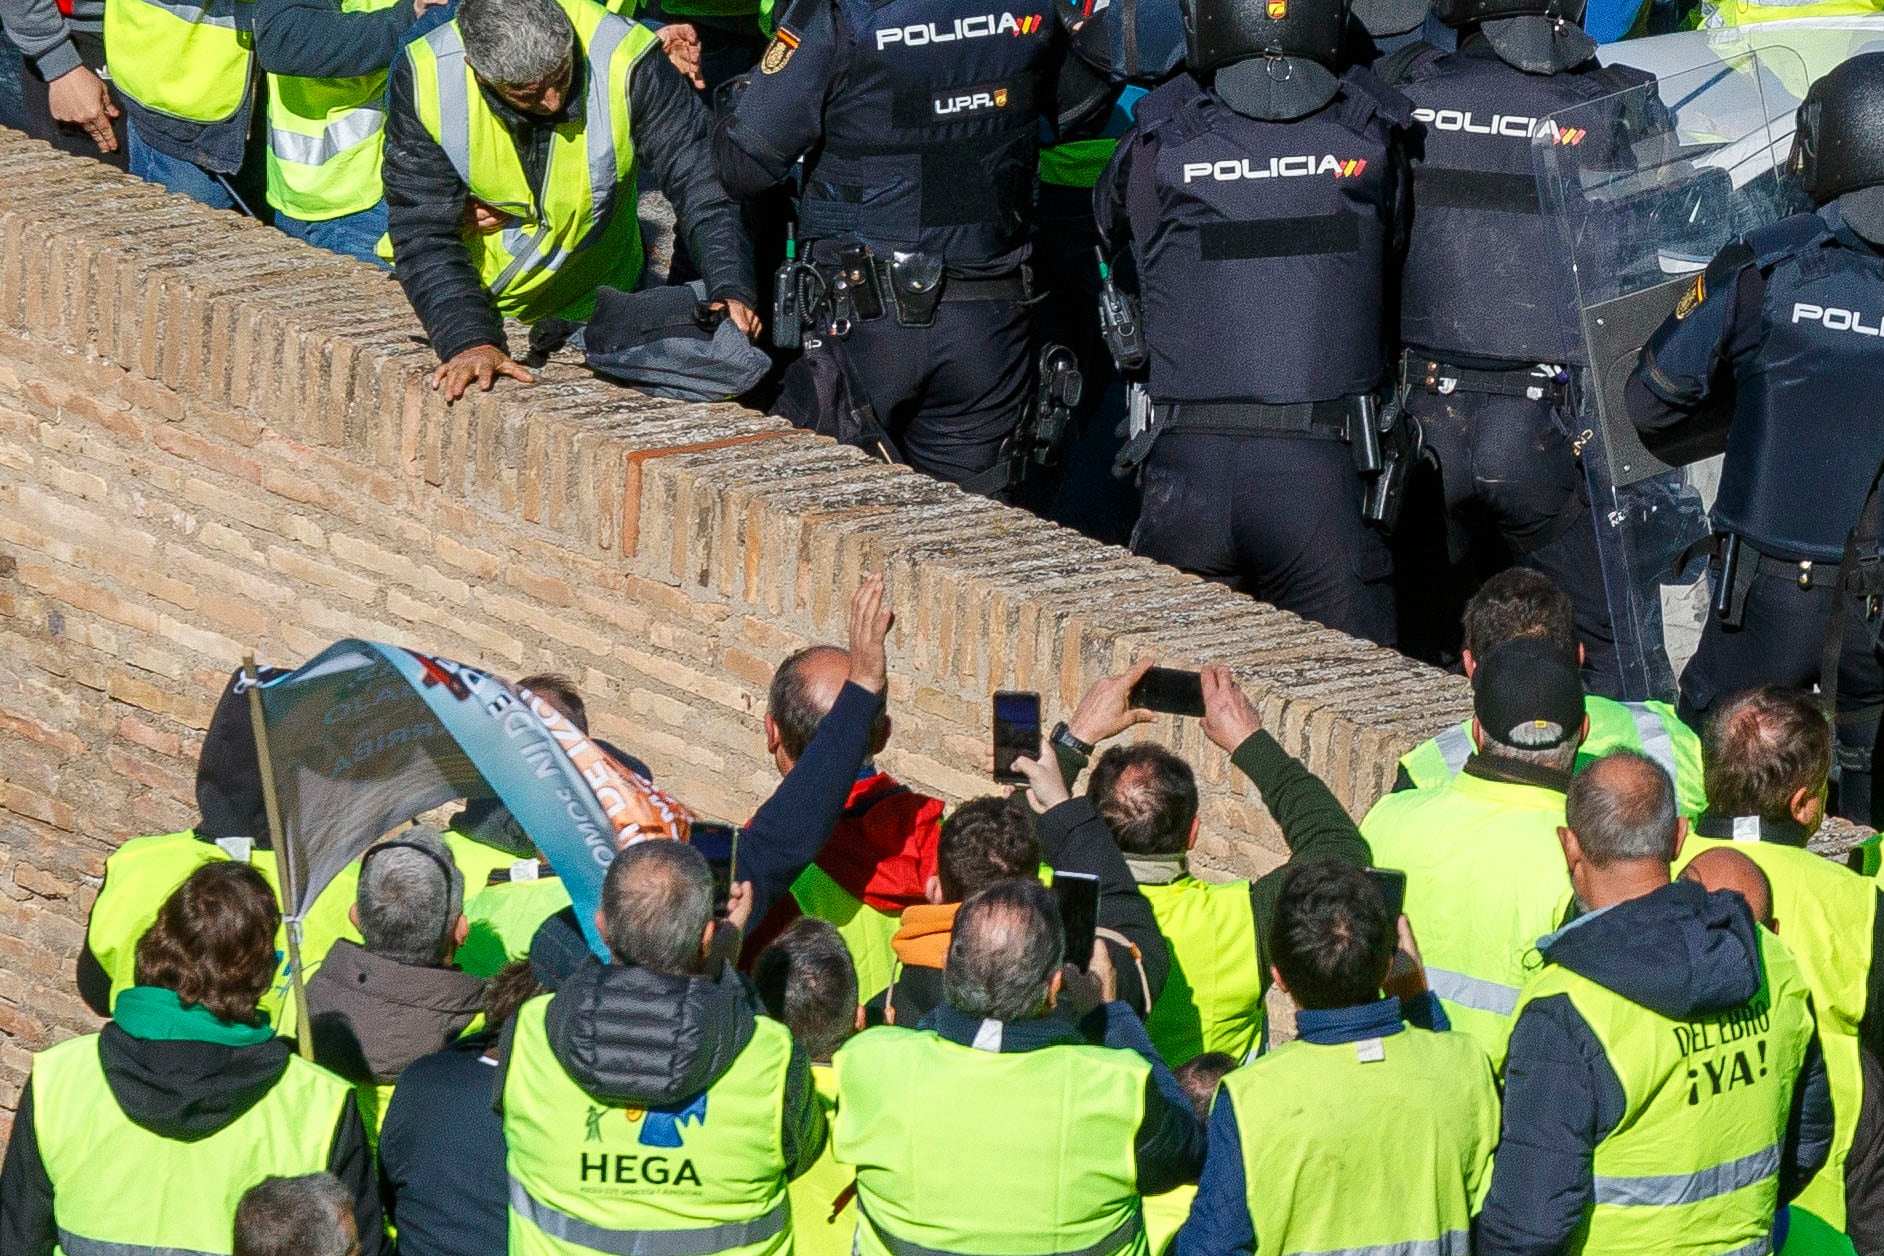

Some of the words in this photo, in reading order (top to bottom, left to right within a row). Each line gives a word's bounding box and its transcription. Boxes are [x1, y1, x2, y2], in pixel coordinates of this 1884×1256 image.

[875, 11, 1020, 51] POLICIA
[1183, 154, 1344, 183] POLICIA
[1673, 1022, 1716, 1058] DEL
[1688, 1040, 1767, 1106] ¡YA!
[581, 1152, 703, 1187] HEGA
